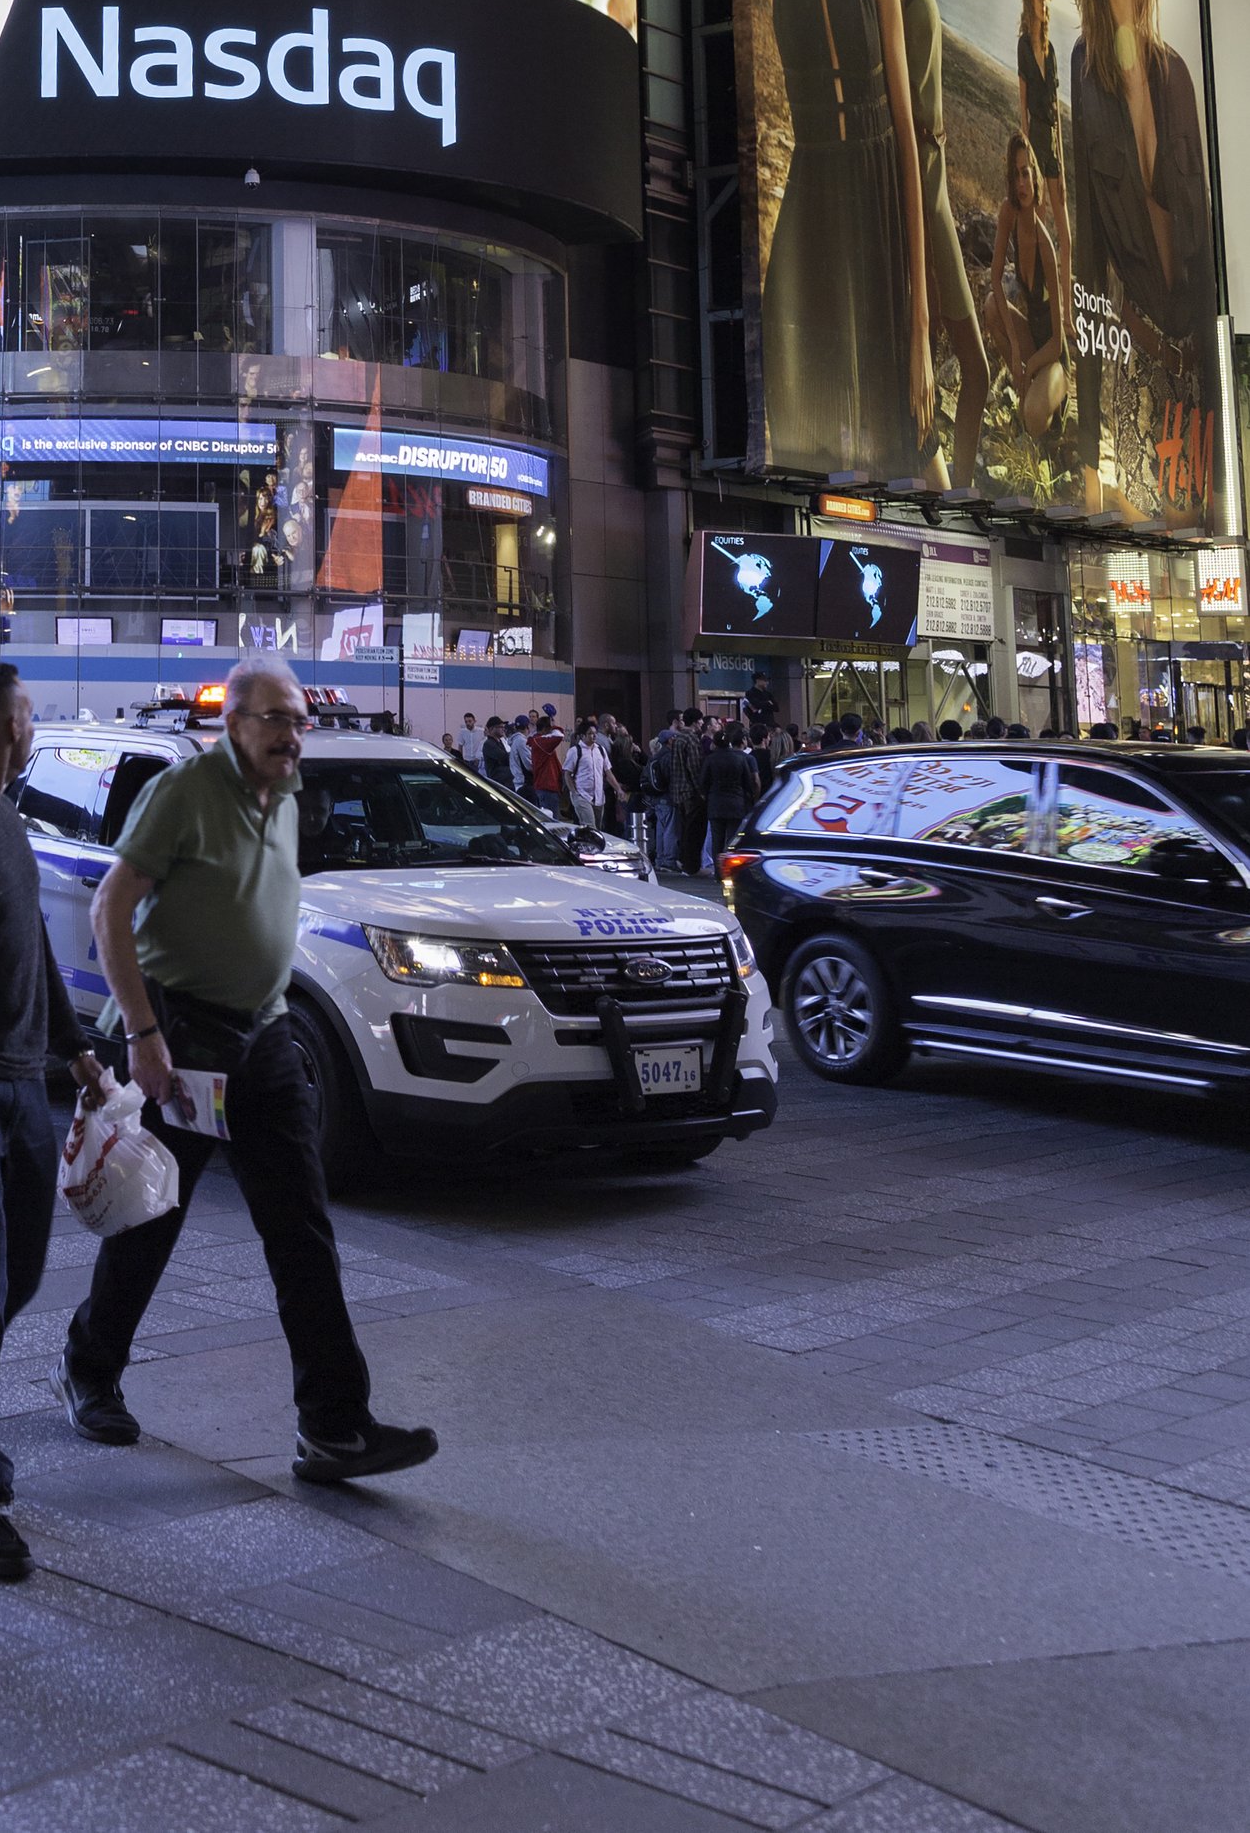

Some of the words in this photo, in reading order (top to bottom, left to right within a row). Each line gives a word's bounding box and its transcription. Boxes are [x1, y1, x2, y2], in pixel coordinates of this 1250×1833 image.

[42, 5, 457, 147] Nasdaq
[1073, 282, 1114, 319] Shorts
[1075, 312, 1132, 365] $14.99
[33, 439, 51, 450] the
[55, 438, 108, 450] exclusive
[110, 440, 157, 456] sponsor
[159, 439, 173, 451] of
[174, 440, 209, 452] CNBC
[211, 441, 264, 455] Disruptor
[1155, 398, 1215, 514] H&M
[367, 453, 398, 464] CNBC
[398, 445, 488, 475] DISRUPTOR
[490, 457, 508, 479] 50
[468, 489, 511, 510] BRANDED
[512, 495, 532, 515] CITIES
[714, 535, 745, 546] EQUITIES
[1201, 578, 1241, 605] H&M
[712, 653, 756, 673] Nasdaq
[641, 1060, 683, 1084] 5047
[683, 1070, 697, 1083] 16
